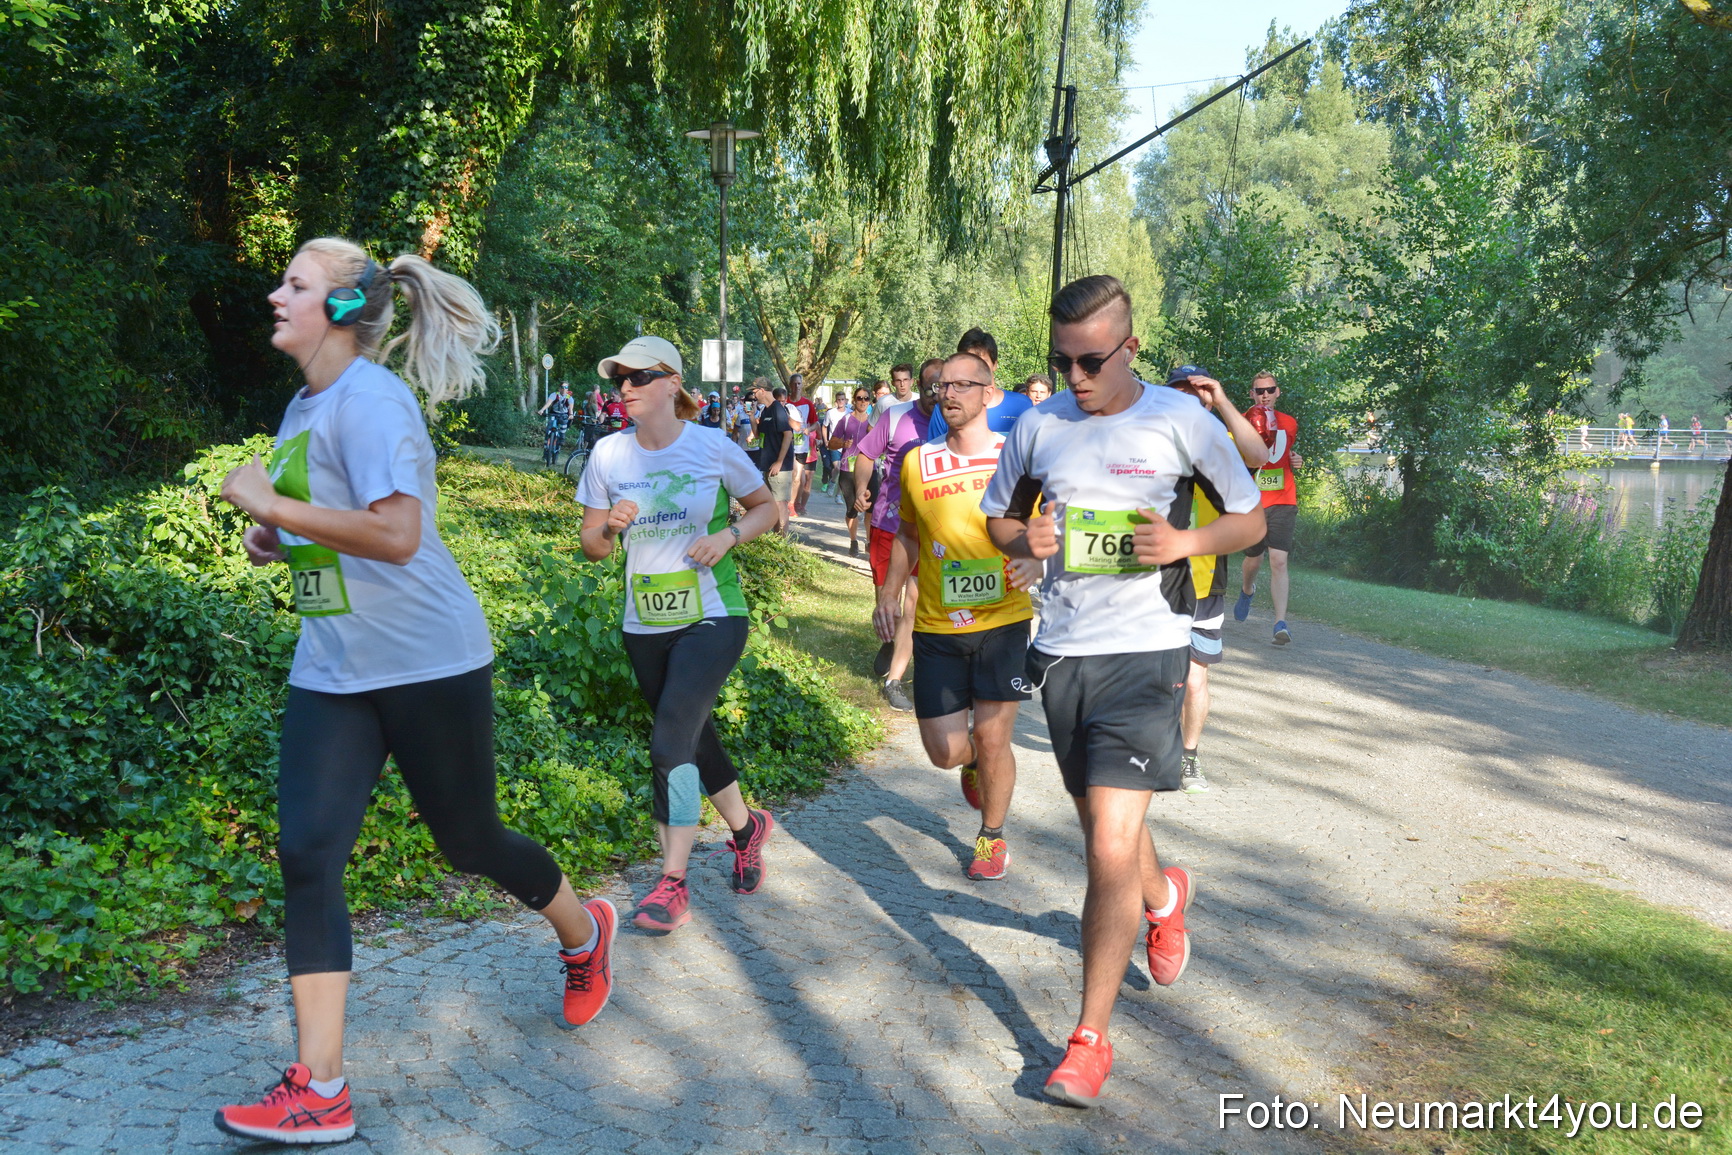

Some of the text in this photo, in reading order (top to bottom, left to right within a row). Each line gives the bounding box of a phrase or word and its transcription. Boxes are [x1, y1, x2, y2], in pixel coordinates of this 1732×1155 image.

[618, 482, 651, 491] BERATA
[1260, 476, 1278, 485] 394
[923, 481, 967, 501] MAX
[630, 523, 697, 541] erfolgreich
[1084, 532, 1135, 556] 766
[949, 574, 996, 594] 1200
[642, 590, 690, 611] 1027
